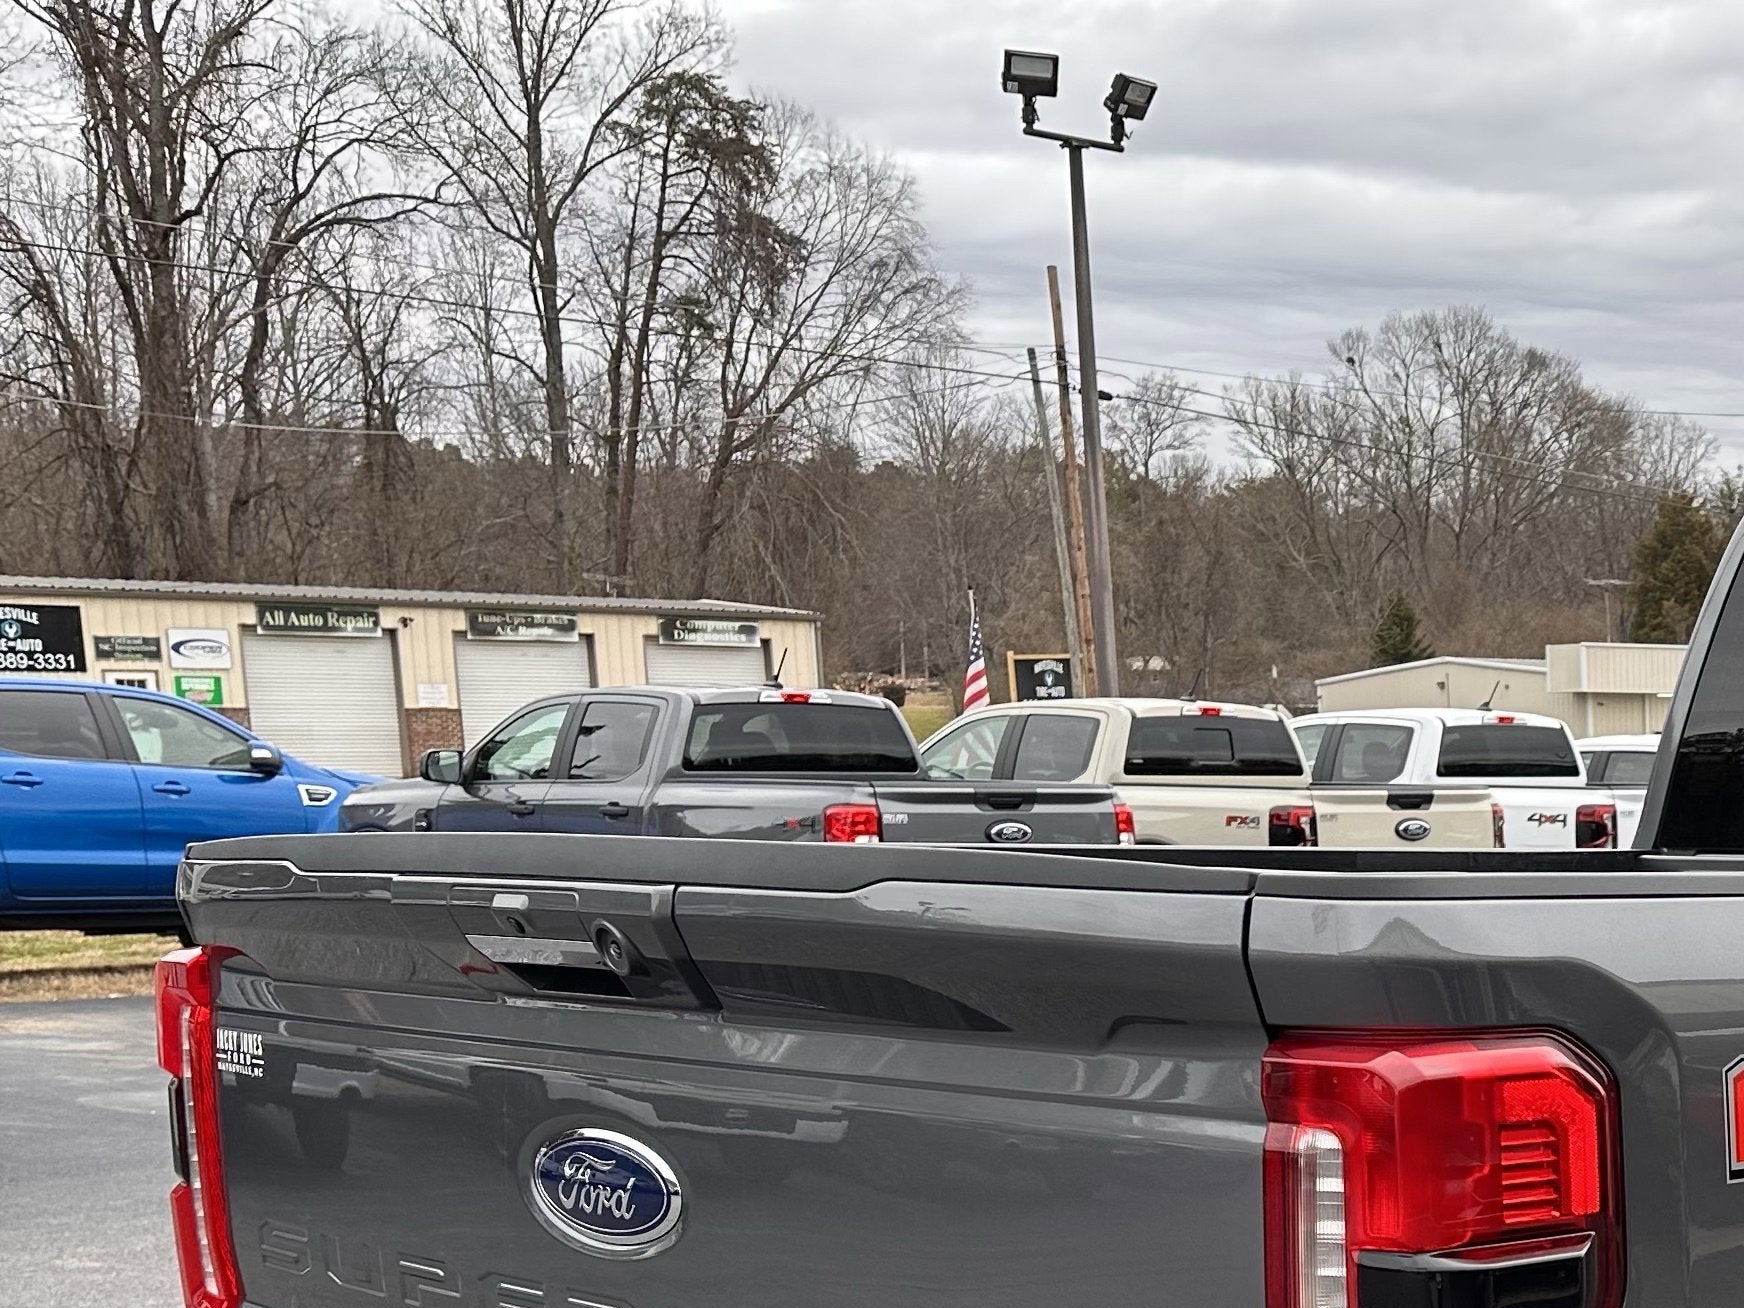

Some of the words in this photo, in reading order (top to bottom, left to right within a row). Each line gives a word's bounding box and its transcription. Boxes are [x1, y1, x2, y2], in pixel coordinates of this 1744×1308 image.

[262, 609, 285, 626] All
[287, 611, 324, 627] Auto
[327, 611, 377, 632] Repair
[675, 619, 739, 632] Computer
[673, 629, 747, 642] Diagnostics
[1225, 814, 1261, 827] FX4
[239, 1031, 263, 1056] JONES
[558, 1151, 637, 1220] Ford
